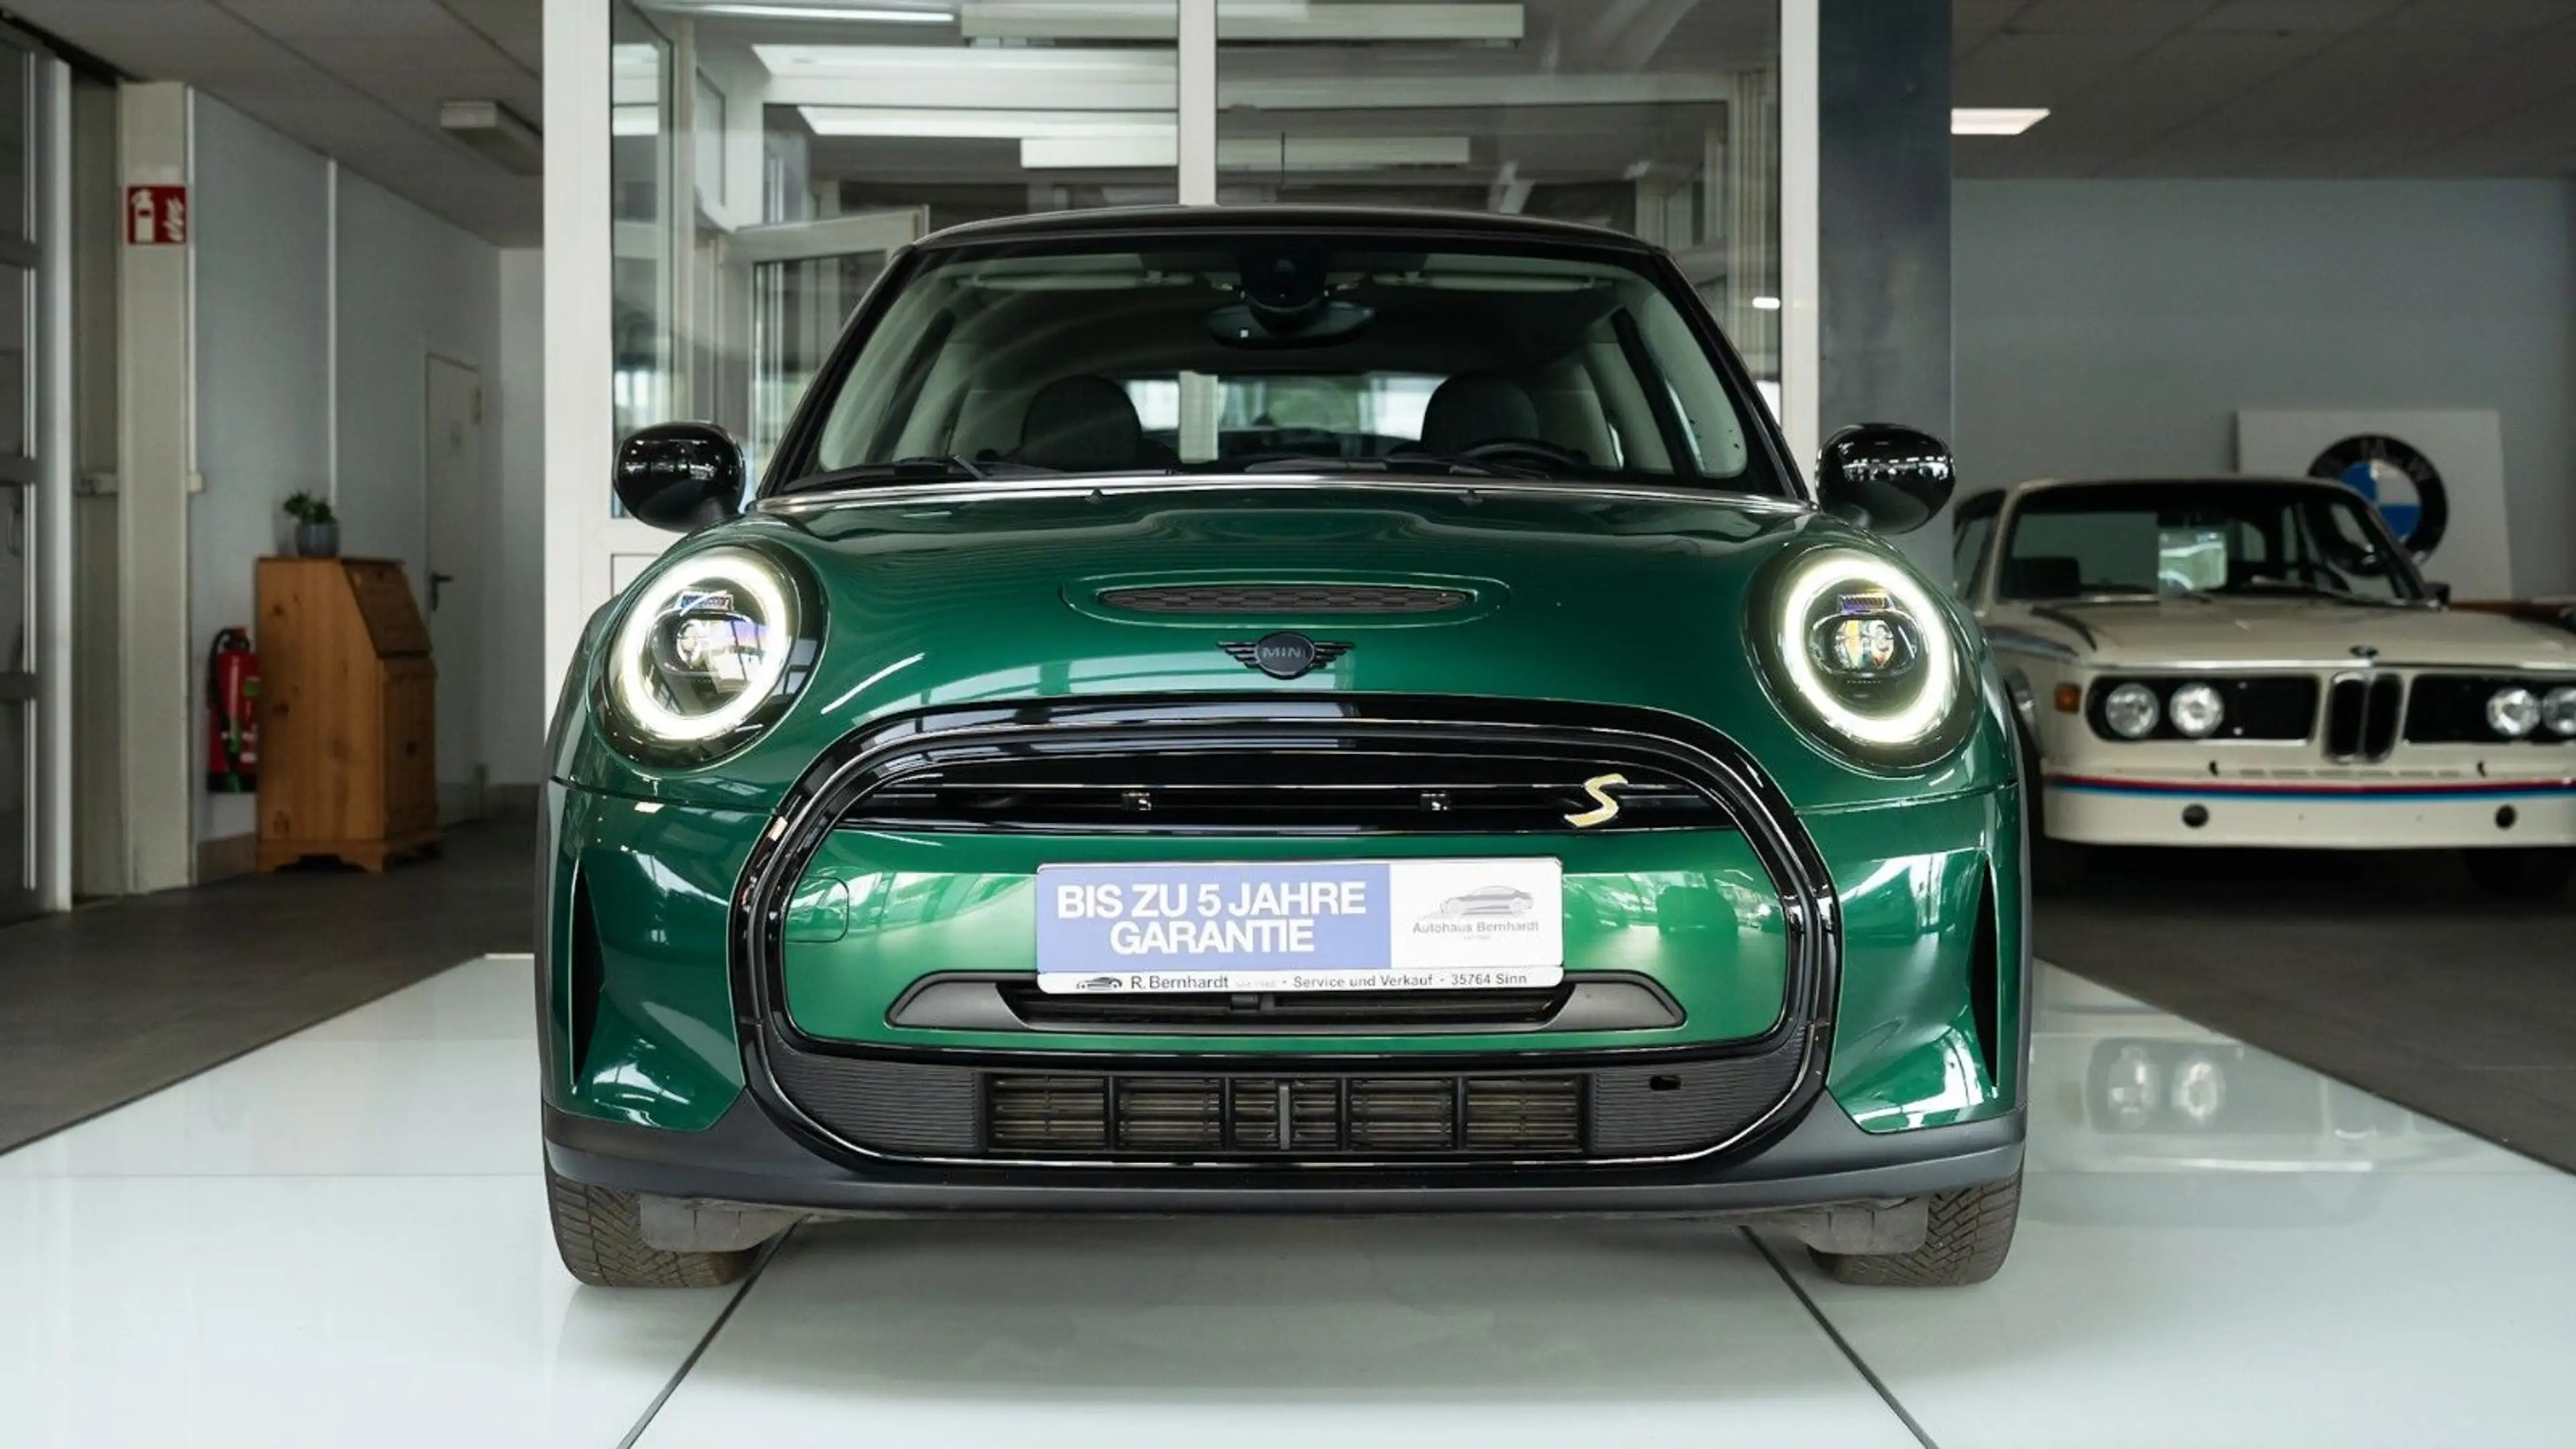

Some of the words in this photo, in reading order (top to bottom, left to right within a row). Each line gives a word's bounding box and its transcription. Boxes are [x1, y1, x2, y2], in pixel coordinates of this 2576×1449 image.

[1262, 646, 1306, 659] MINI
[1563, 773, 1629, 827] S
[1057, 883, 1124, 919] BIS
[1130, 883, 1188, 918] ZU
[1197, 883, 1222, 917] 5
[1228, 881, 1366, 917] JAHRE
[1110, 918, 1316, 955] GARANTIE
[1412, 922, 1473, 934] Autohaus
[1476, 921, 1539, 932] Bernhardt
[1130, 976, 1146, 989] R.
[1149, 975, 1229, 989] Bernhardt
[1293, 976, 1348, 988] Service
[1349, 976, 1376, 987] und
[1380, 975, 1433, 986] Verkauf
[1451, 973, 1491, 985] 35764
[1496, 973, 1527, 985] Sinn
